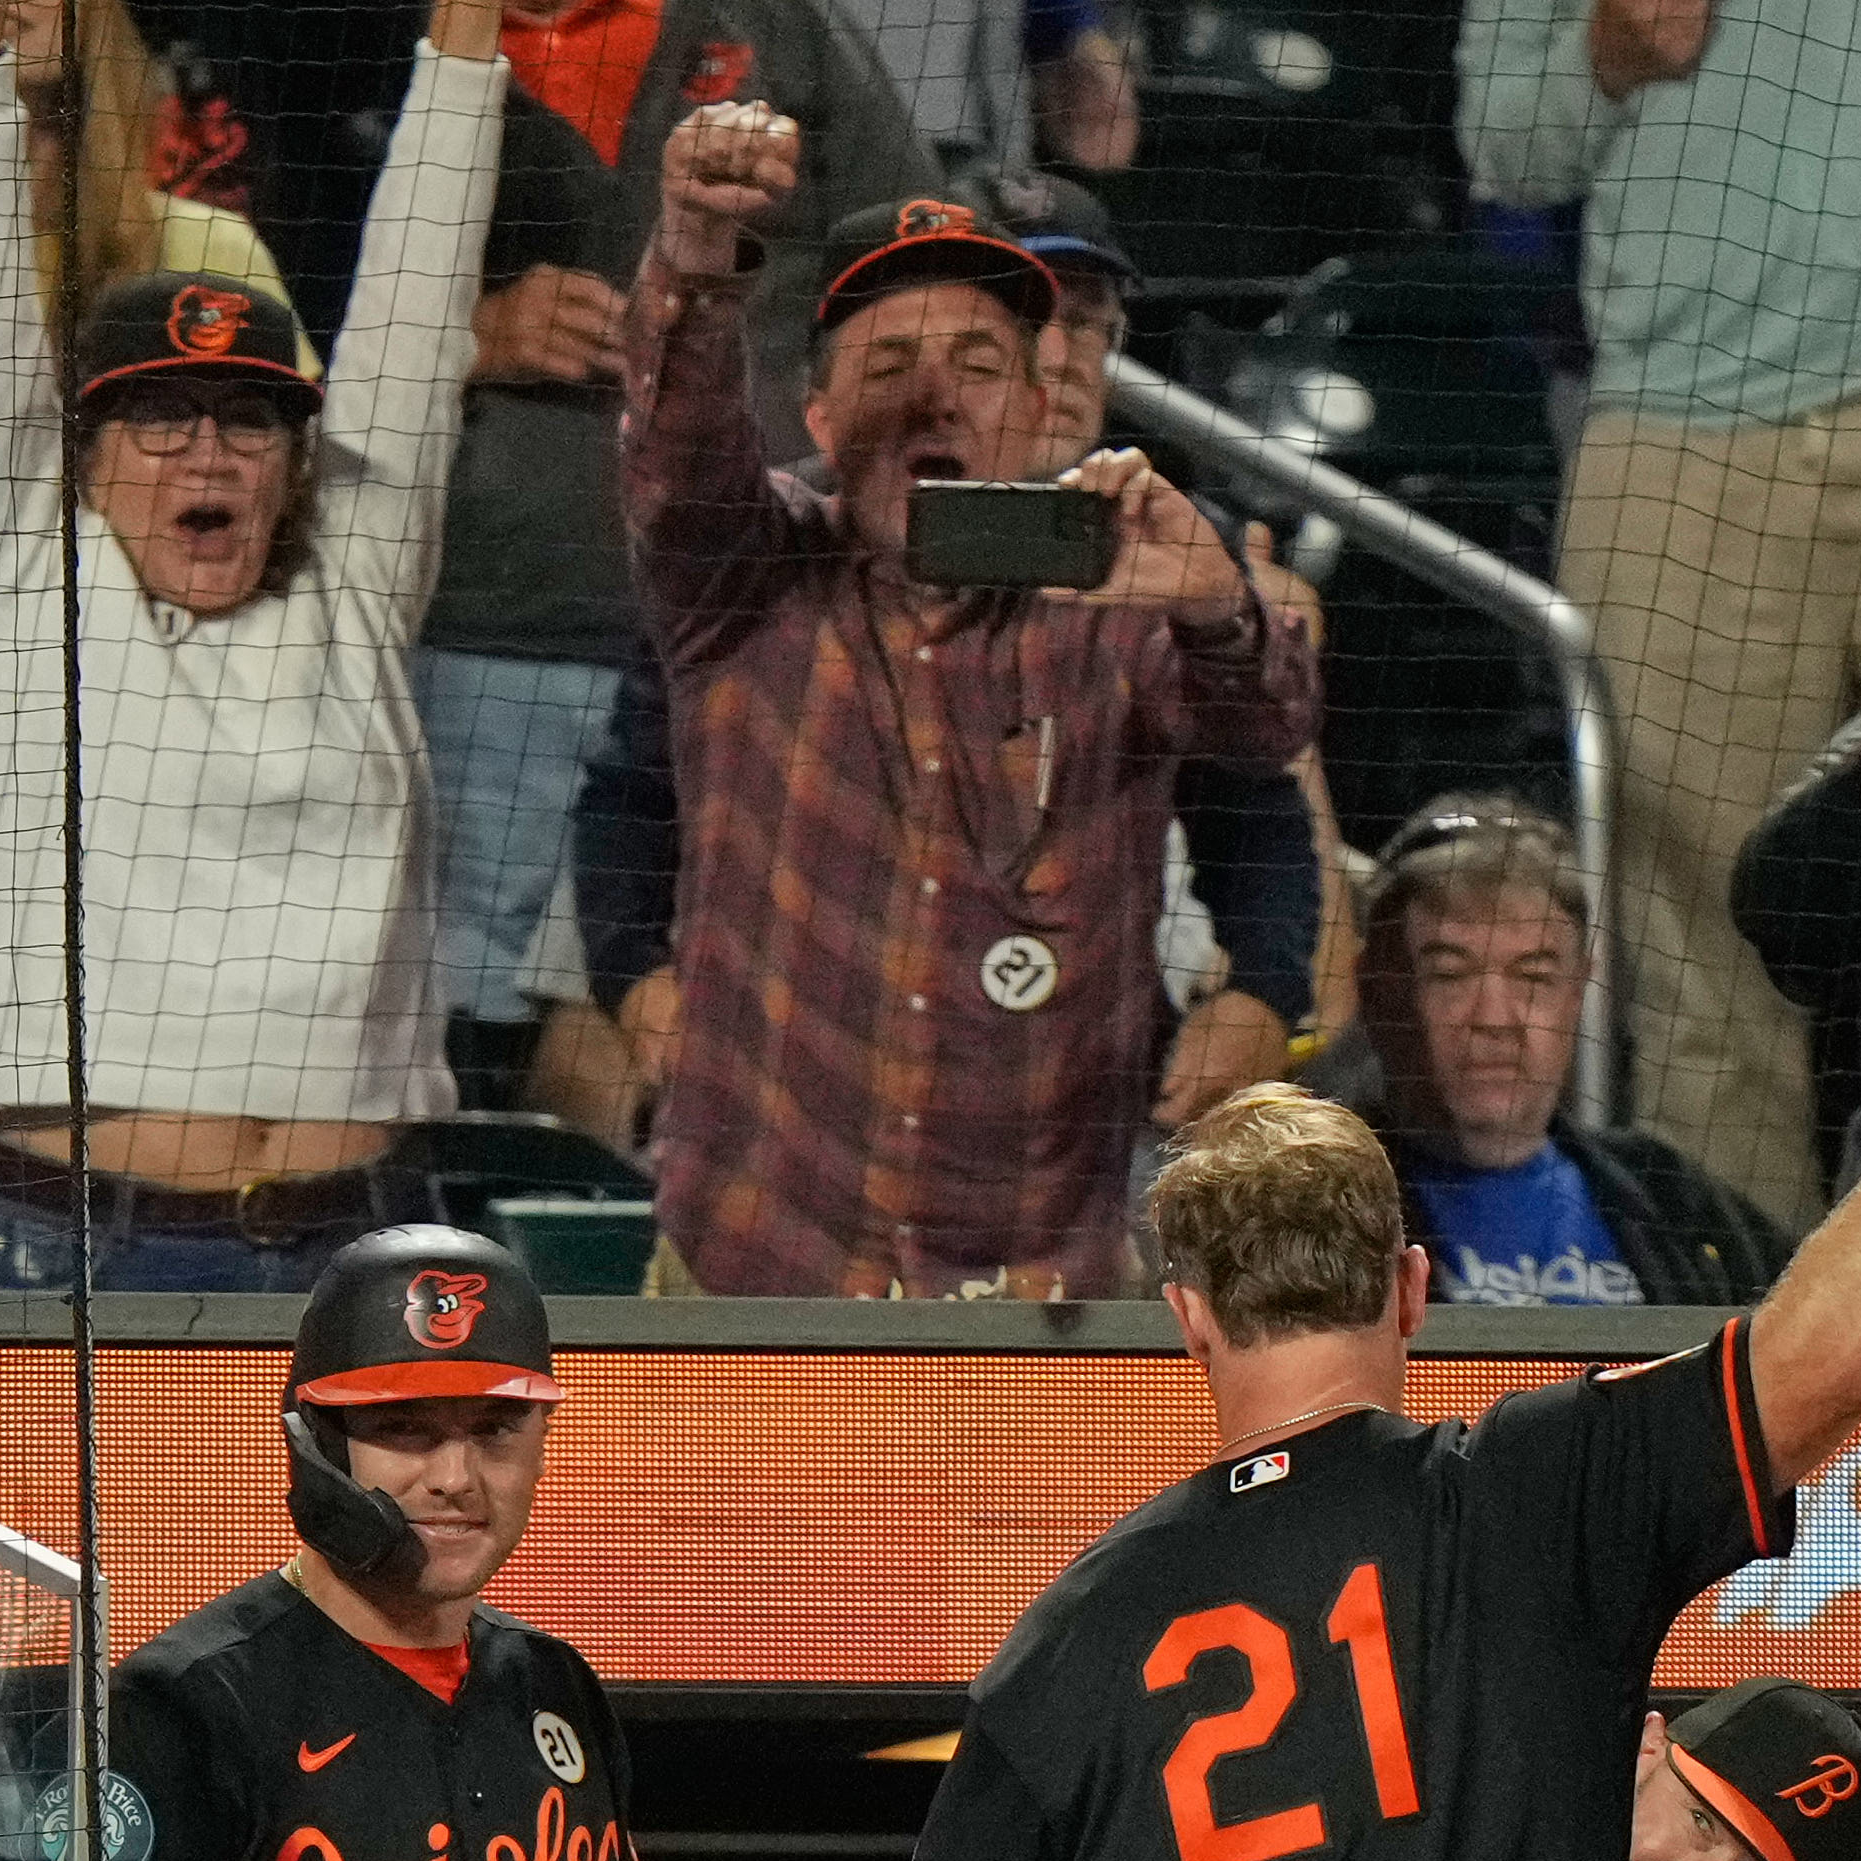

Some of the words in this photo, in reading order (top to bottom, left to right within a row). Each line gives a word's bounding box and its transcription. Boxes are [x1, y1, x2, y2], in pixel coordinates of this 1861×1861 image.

[994, 948, 1045, 998] 21
[541, 1727, 577, 1766] 21
[106, 1781, 142, 1828] Price
[1774, 1754, 1858, 1818] B
